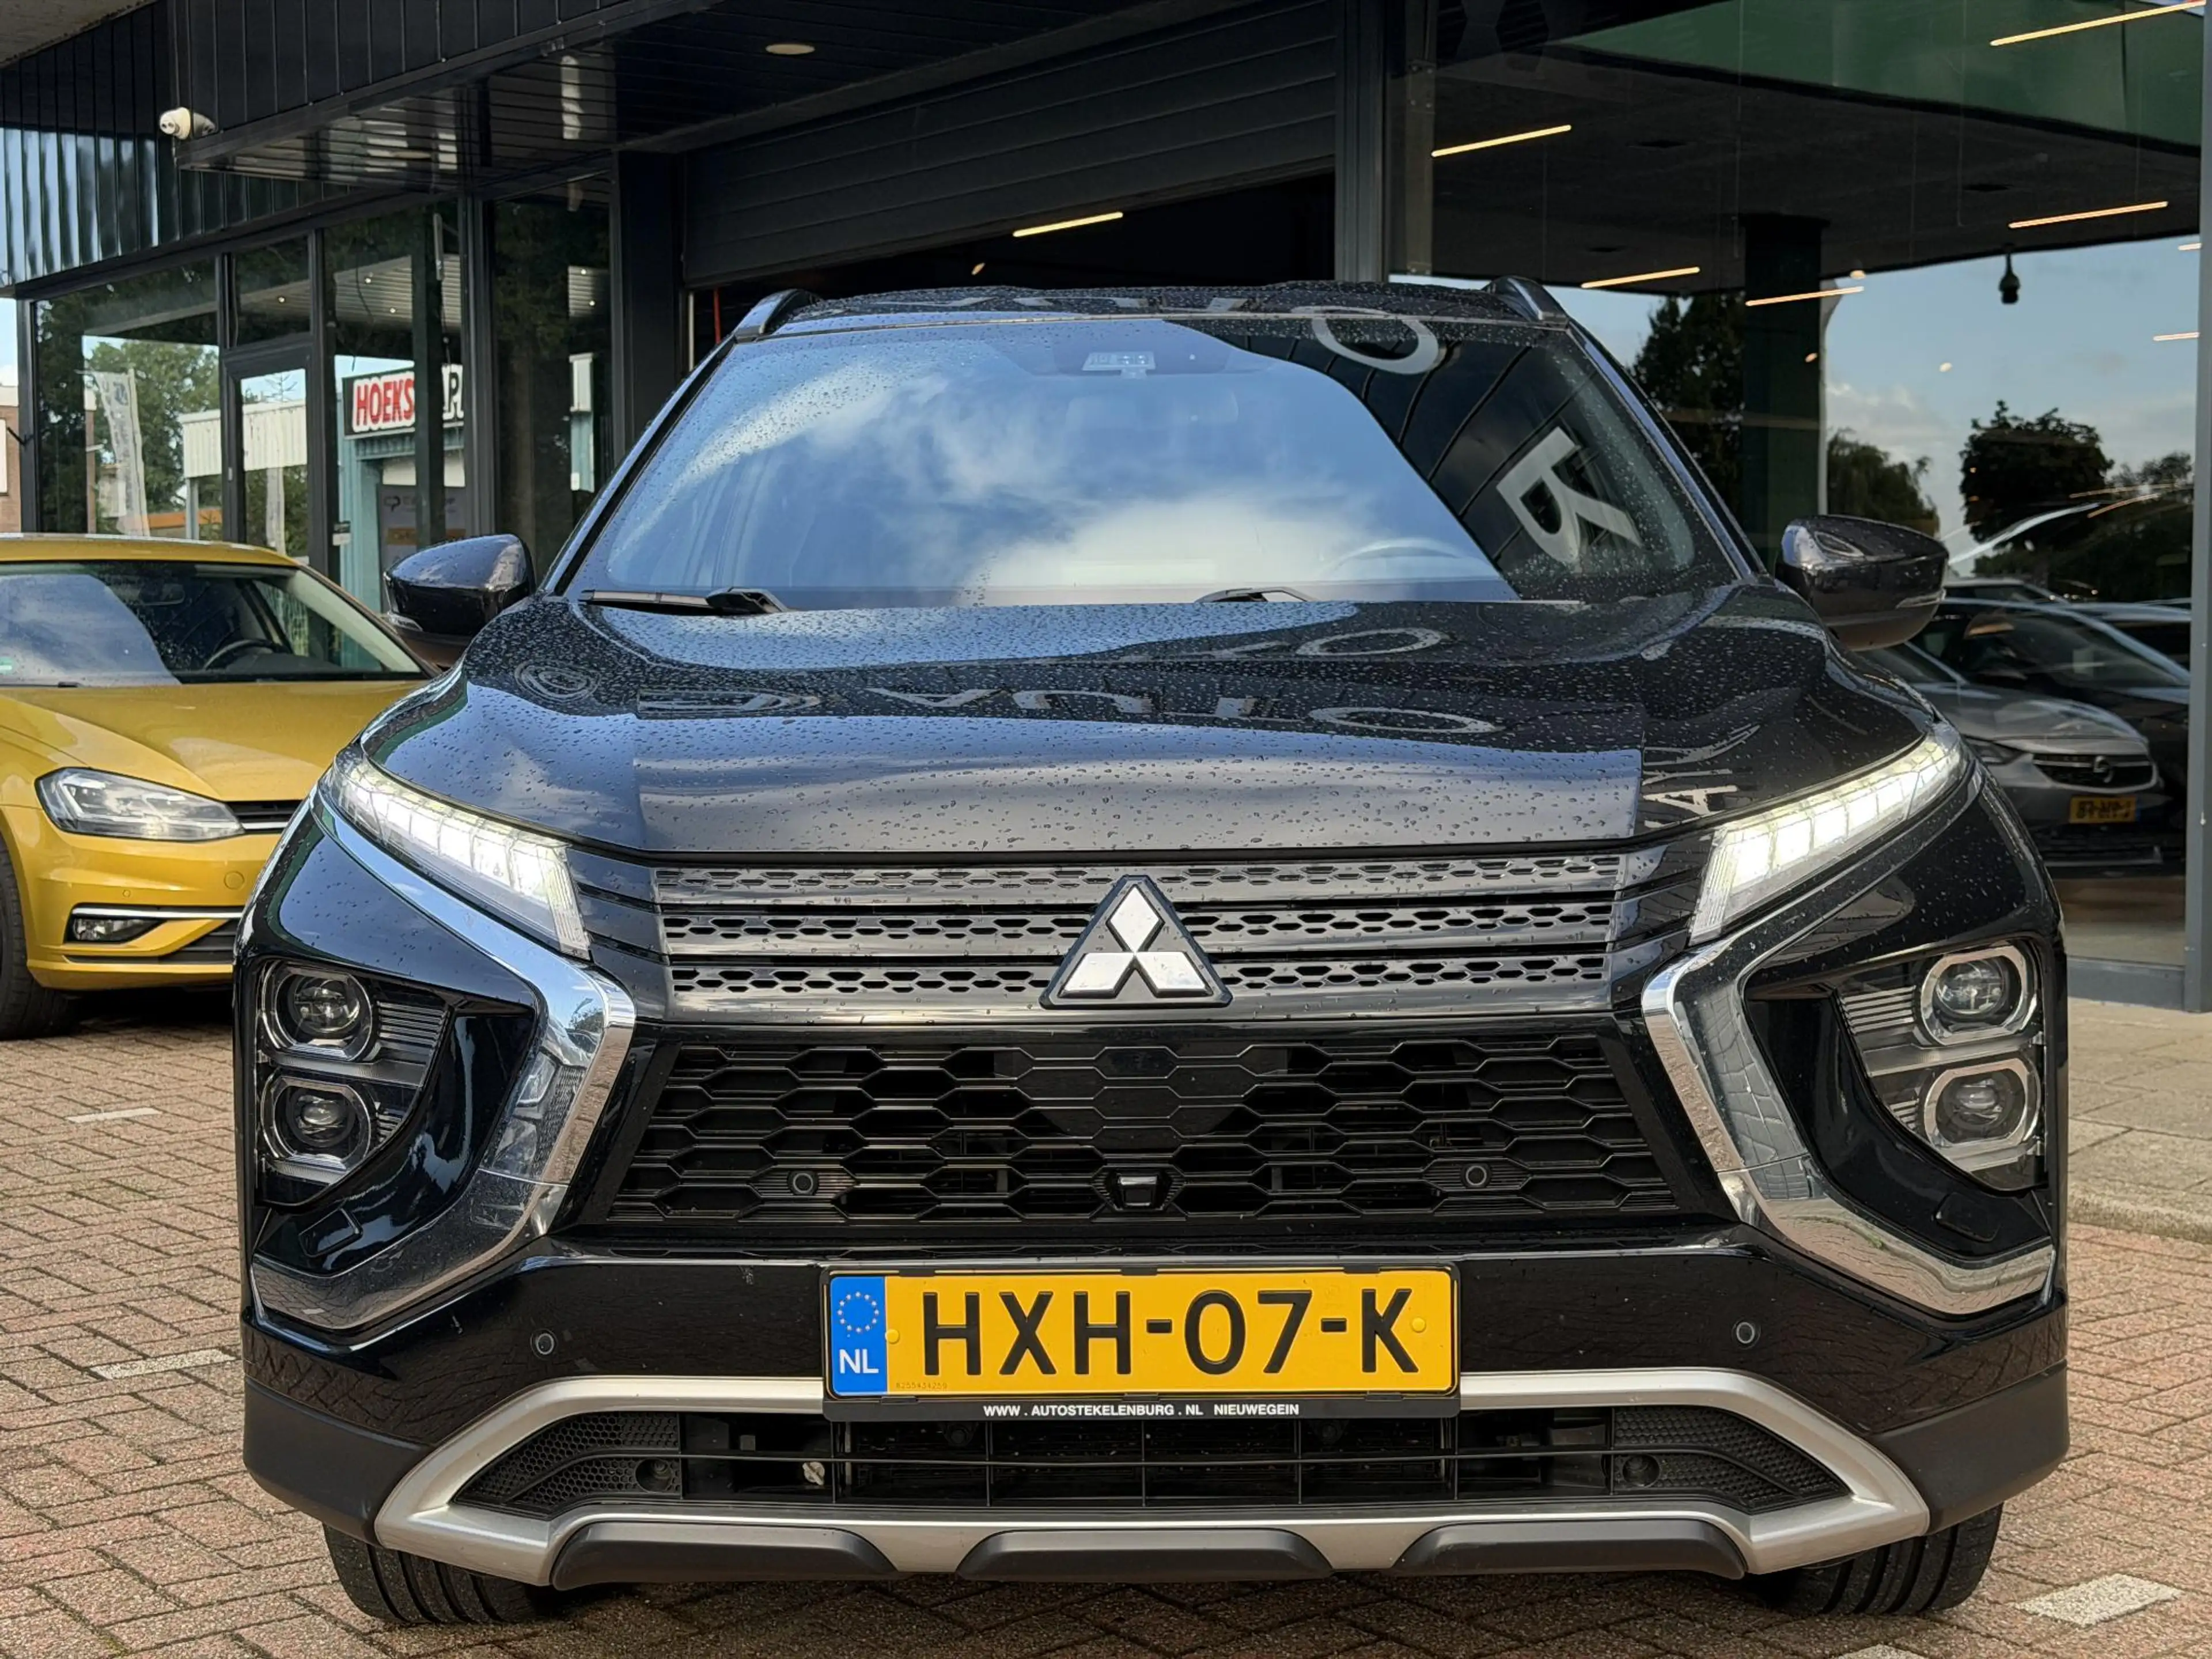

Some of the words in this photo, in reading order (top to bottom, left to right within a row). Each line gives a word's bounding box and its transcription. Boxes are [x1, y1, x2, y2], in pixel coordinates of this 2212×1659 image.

[923, 1288, 1419, 1376] HXH-07-K
[839, 1349, 879, 1373] NL
[1214, 1403, 1299, 1415] NIEUWEGEIN
